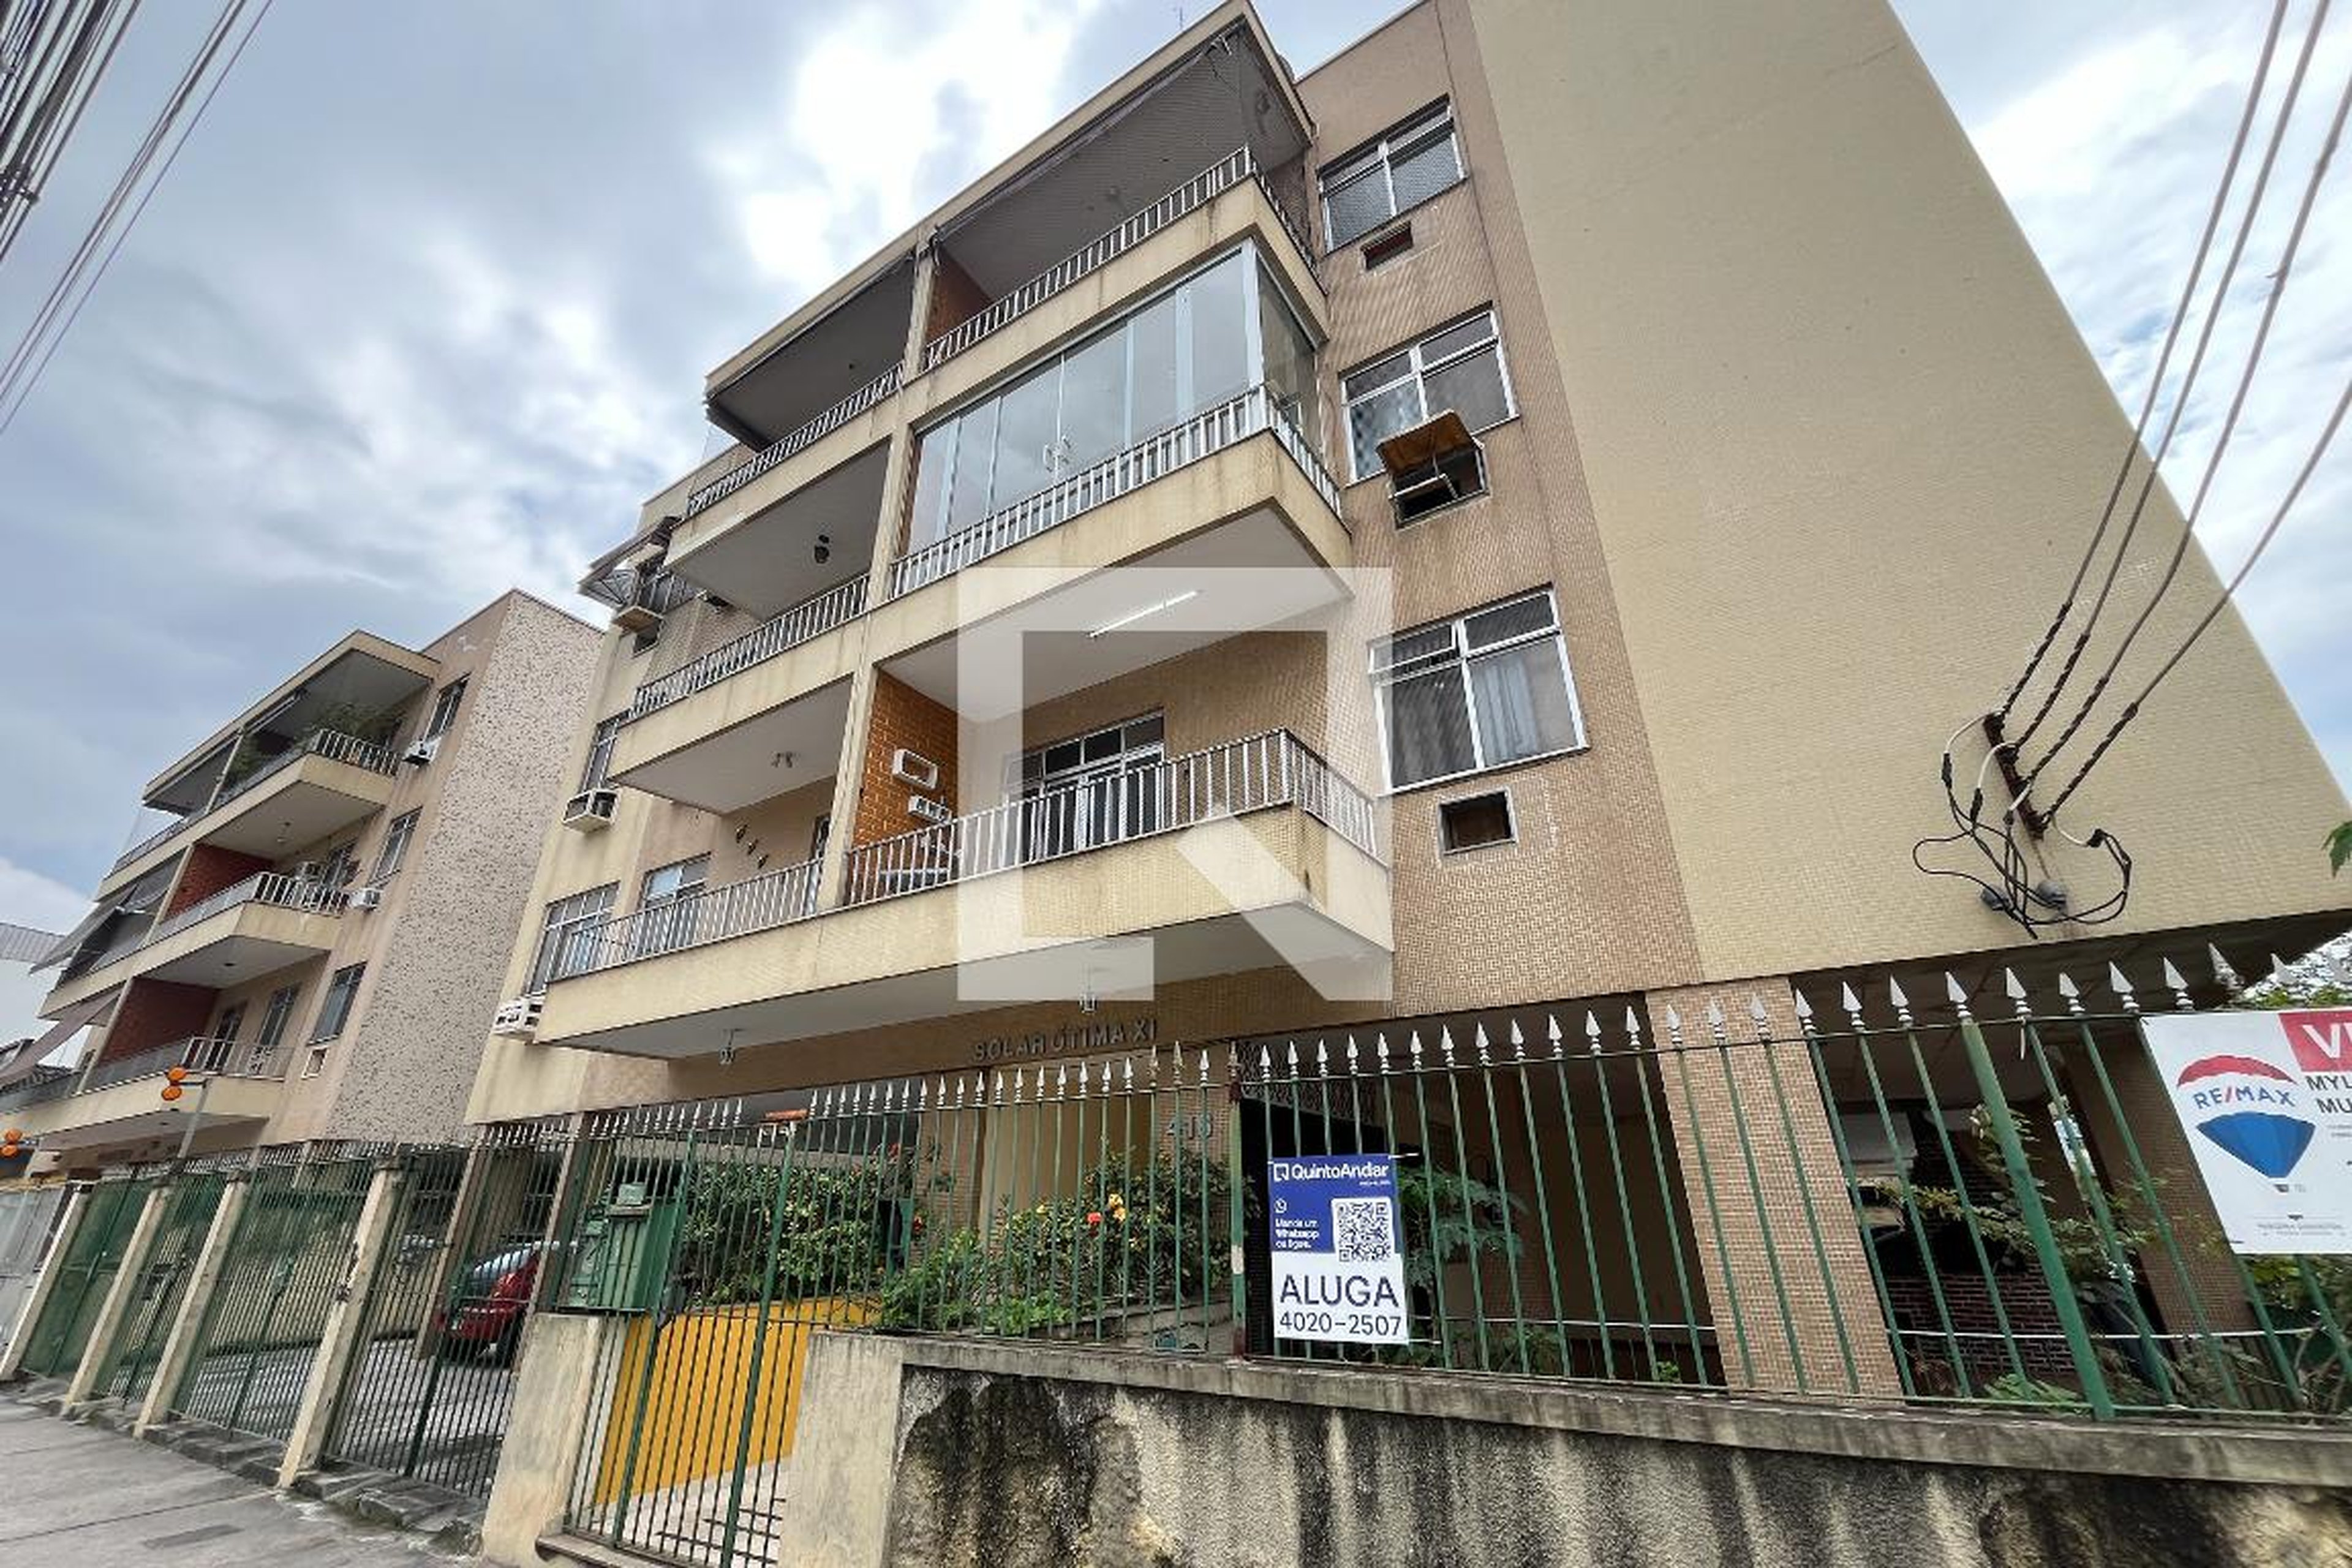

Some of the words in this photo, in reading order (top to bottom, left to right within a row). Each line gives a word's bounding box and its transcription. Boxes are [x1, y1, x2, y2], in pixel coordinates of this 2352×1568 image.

[974, 1033, 1046, 1061] SOLAR
[1133, 1018, 1157, 1042] XI
[2301, 1022, 2352, 1058] V
[2193, 1086, 2296, 1109] RE/MAX
[1291, 1161, 1389, 1180] QuintoAndar
[1280, 1275, 1399, 1307] ALUGA
[1280, 1311, 1401, 1335] 4020-2507
